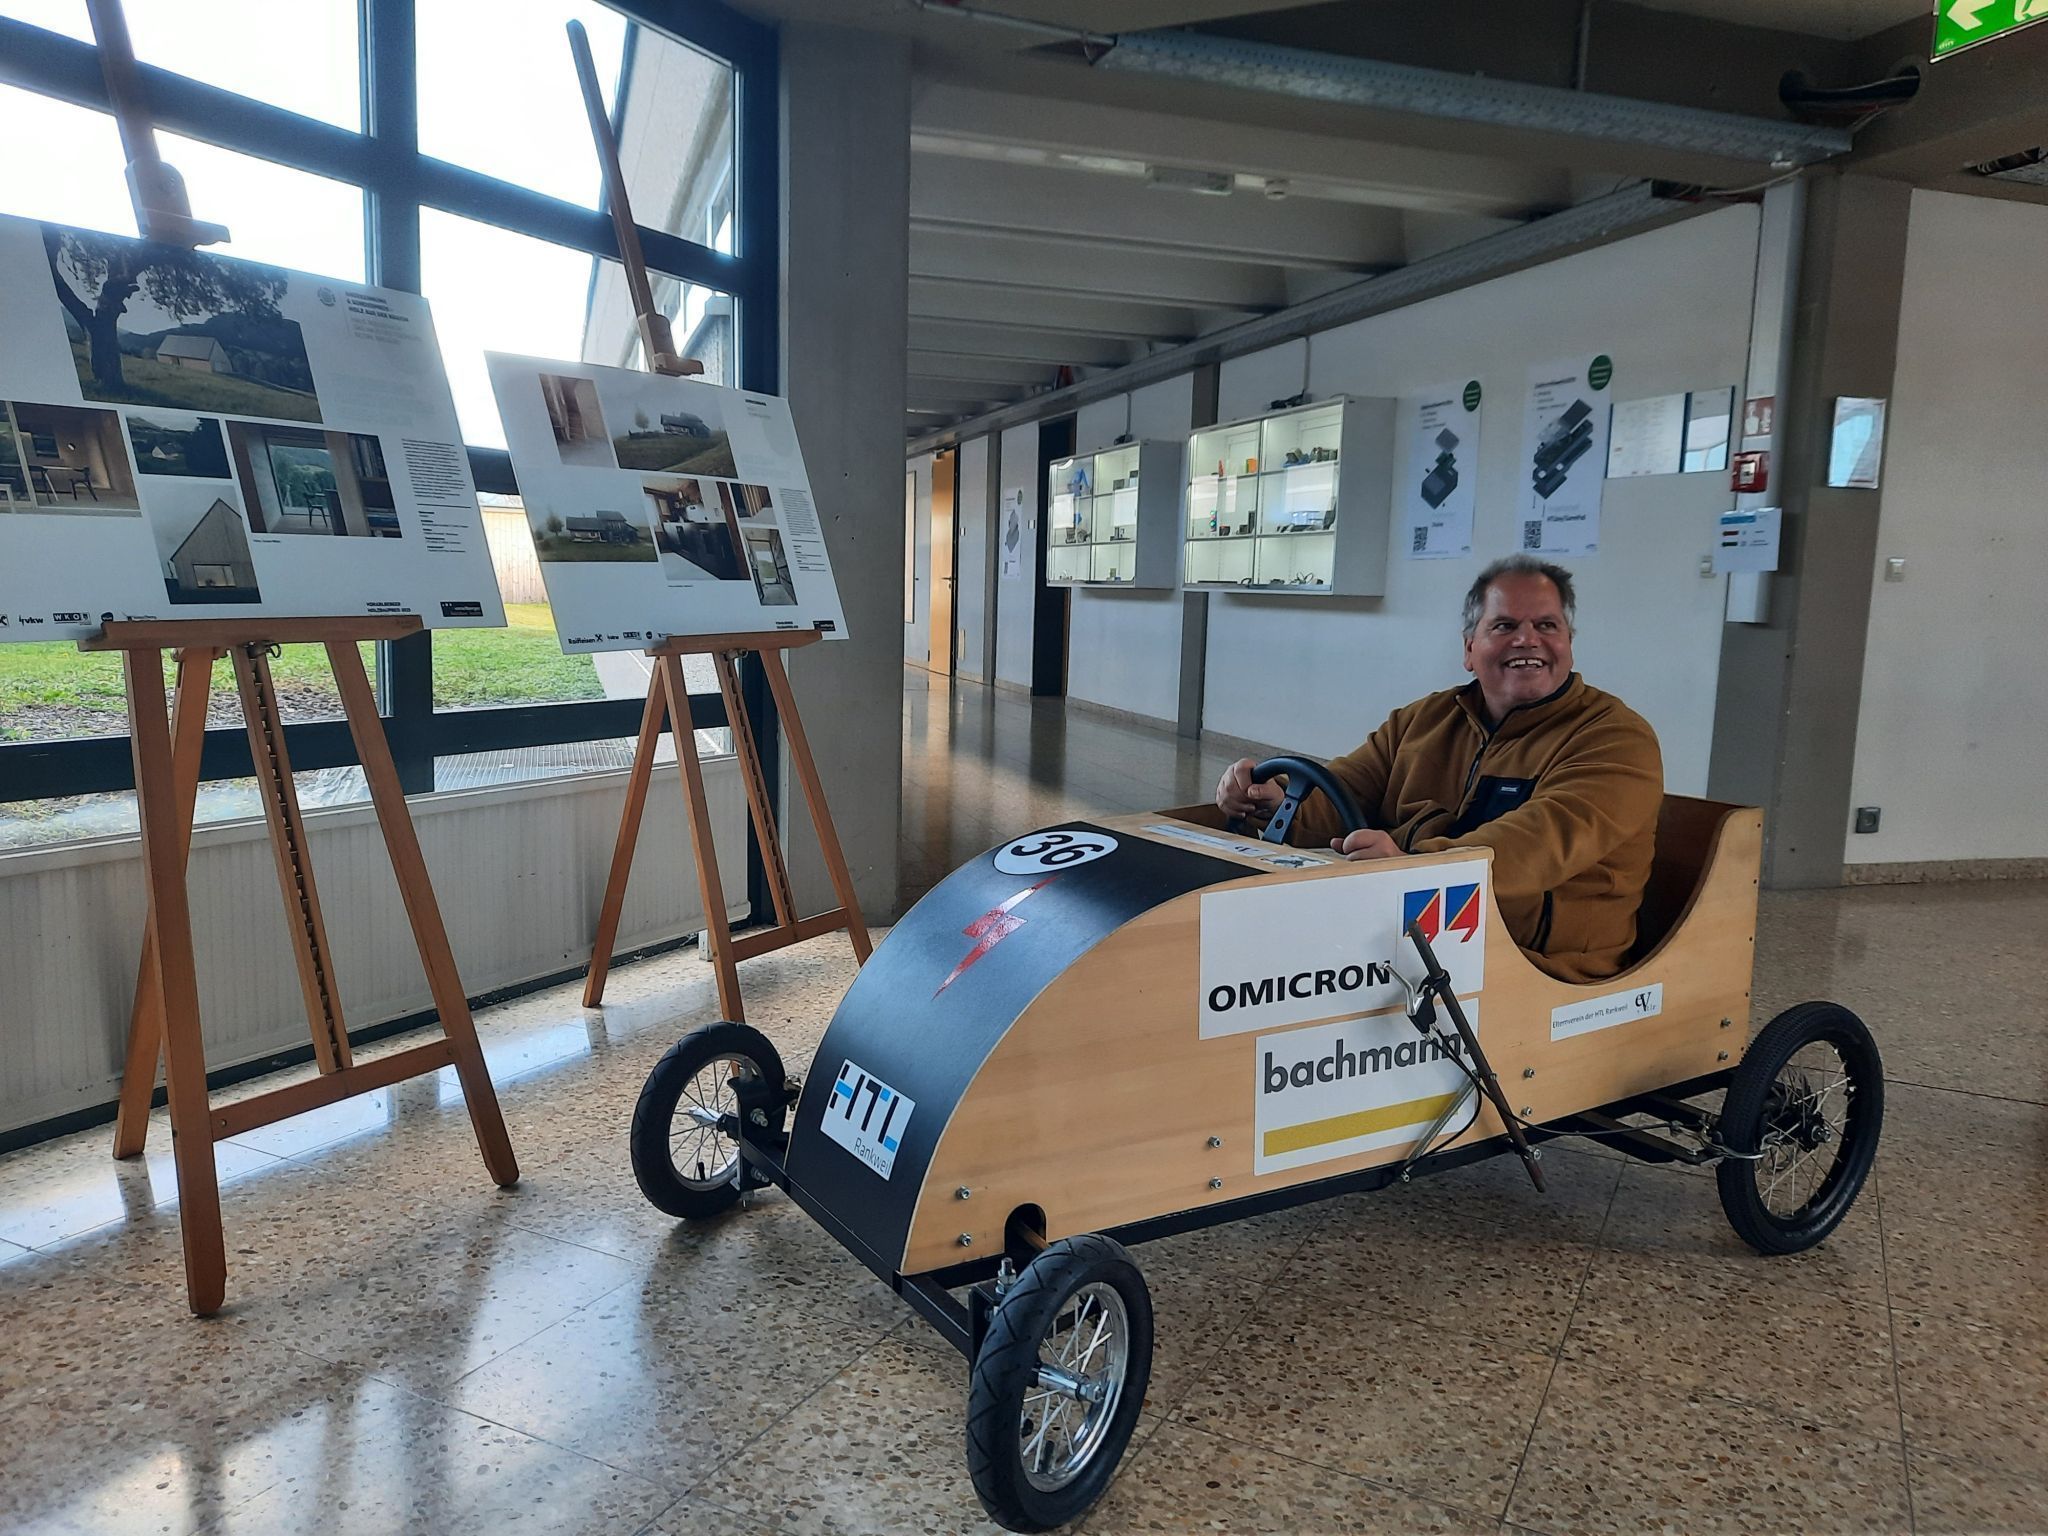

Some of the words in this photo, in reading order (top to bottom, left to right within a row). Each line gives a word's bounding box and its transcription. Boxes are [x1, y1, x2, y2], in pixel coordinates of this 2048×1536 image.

[53, 613, 81, 621] WKO
[1011, 834, 1105, 866] 36
[1208, 960, 1391, 1012] OMICRON
[1552, 1015, 1584, 1028] Elternverein
[1585, 1011, 1595, 1020] der
[1595, 1009, 1604, 1018] HTL
[1605, 1004, 1628, 1015] Rankweil
[829, 1063, 899, 1153] HTL
[854, 1137, 892, 1177] Rankweil
